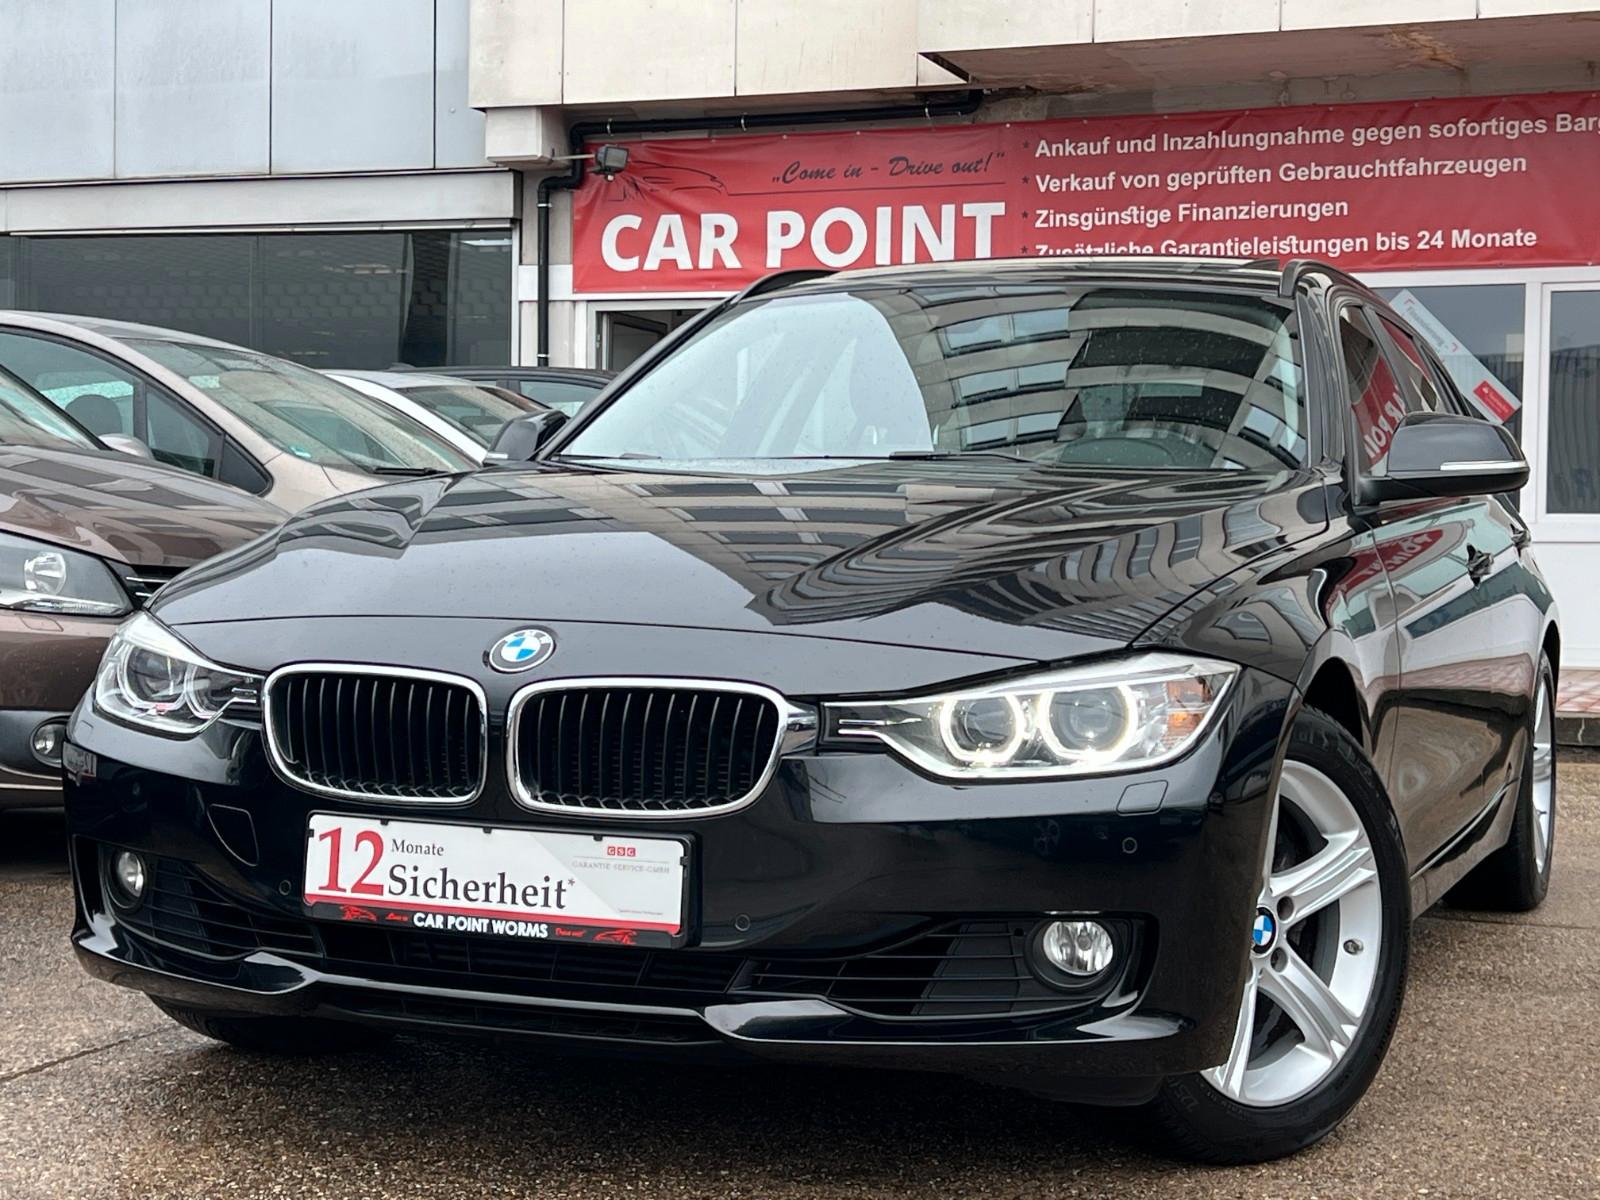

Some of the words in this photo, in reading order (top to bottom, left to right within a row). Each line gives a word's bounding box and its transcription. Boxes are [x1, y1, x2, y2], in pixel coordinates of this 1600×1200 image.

[1035, 136, 1111, 158] Ankauf
[1116, 134, 1157, 154] und
[1163, 126, 1345, 152] Inzahlungnahme
[1351, 123, 1422, 147] gegen
[1428, 116, 1548, 140] sofortiges
[1556, 113, 1600, 135] Bar
[843, 163, 863, 179] in
[888, 156, 944, 177] Drive
[1035, 171, 1115, 193] Verkauf
[1121, 174, 1160, 189] von
[1166, 166, 1272, 192] geprüften
[1278, 156, 1528, 182] Gebrauchtfahrzeugen
[1034, 206, 1172, 232] Zinsgünstige
[1177, 201, 1349, 223] Finanzierungen
[601, 212, 742, 272] CAR
[765, 201, 1007, 269] POINT
[1160, 235, 1369, 258] Garantieleistungen
[1376, 231, 1410, 251] bis
[1416, 229, 1445, 250] 24
[1451, 227, 1538, 249] Monate
[317, 826, 385, 897] 12
[391, 838, 445, 857] Monate
[413, 912, 444, 929] CAR
[447, 915, 490, 933] POINT
[491, 919, 549, 938] WORMS
